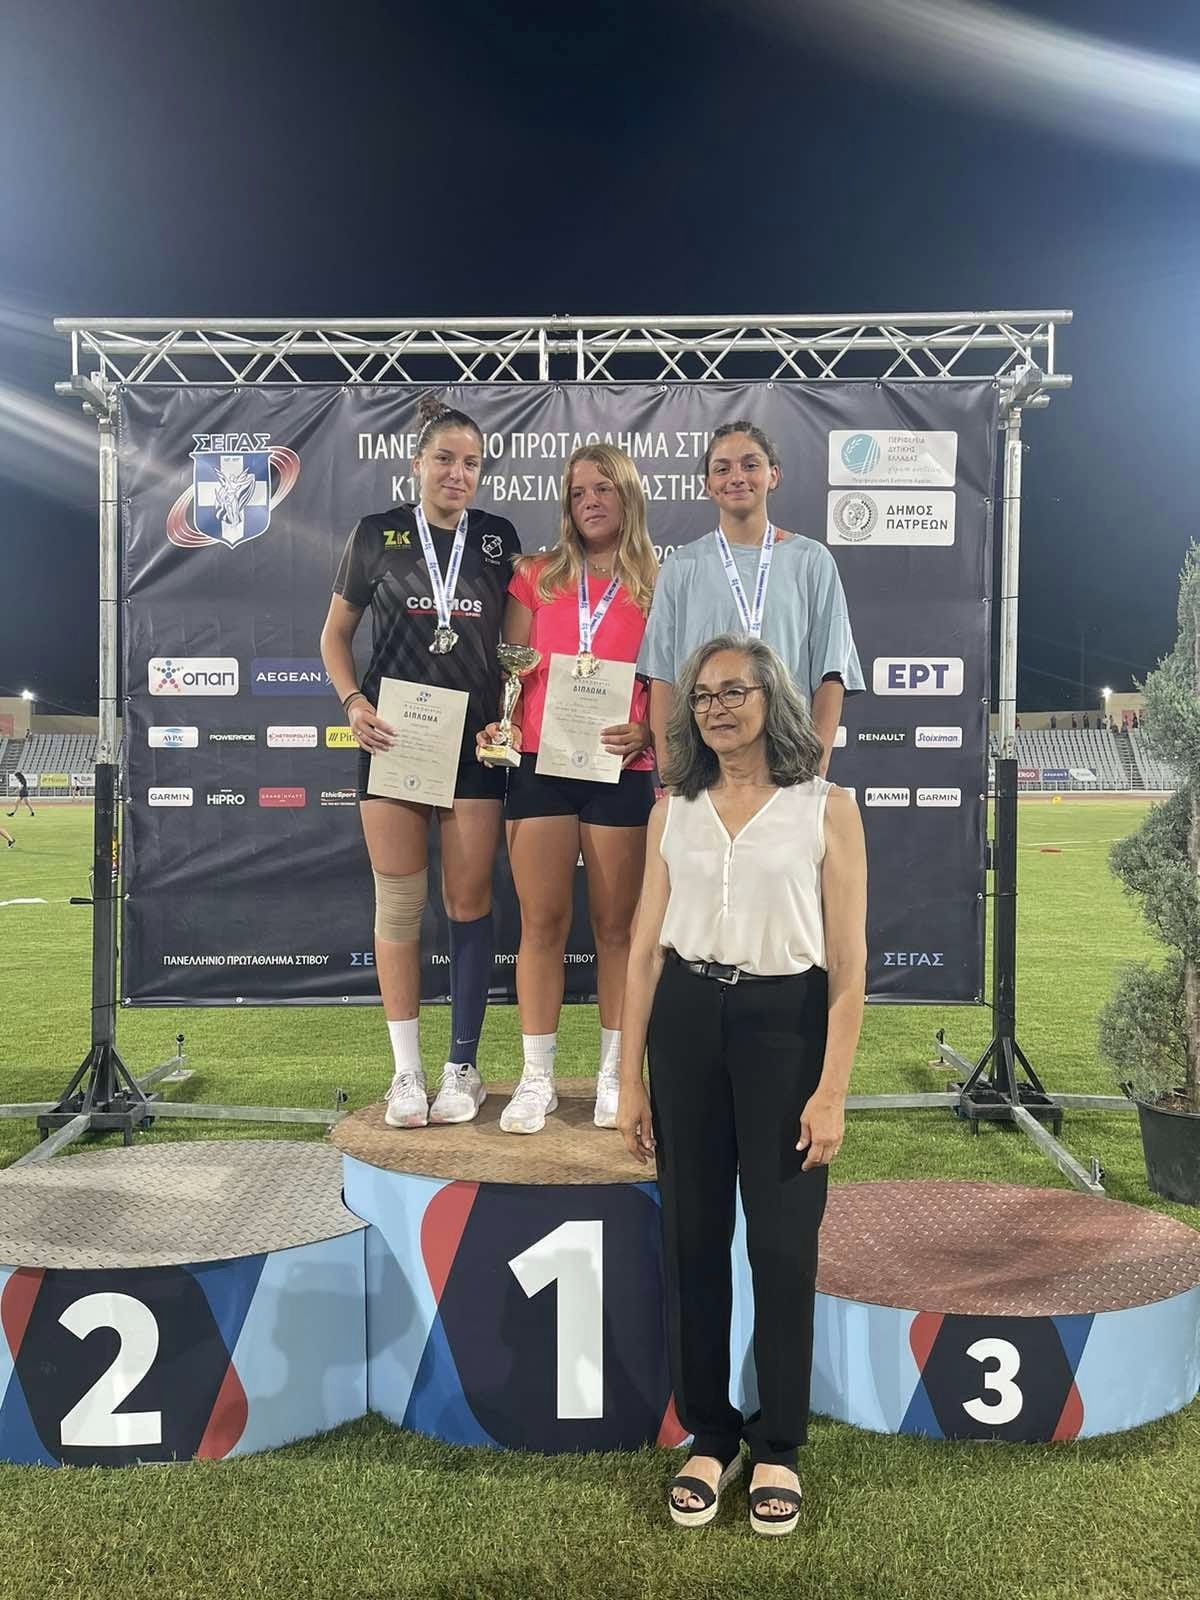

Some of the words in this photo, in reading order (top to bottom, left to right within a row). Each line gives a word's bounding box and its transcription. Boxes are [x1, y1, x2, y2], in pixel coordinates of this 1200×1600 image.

[192, 432, 271, 453] ΣΕΓΑΣ
[358, 432, 504, 459] ΠΑΝΕΙΟ
[675, 431, 714, 458] ΣΤΙ
[886, 504, 934, 516] ΔΗΜΟΣ
[886, 518, 949, 531] ΠΑΤΡΕΩΝ
[255, 671, 321, 683] AEGEAN
[887, 663, 950, 690] ΕΡΤ
[573, 685, 608, 696] ΔΙΠΛΩΜΑ
[403, 710, 439, 723] ΔΙΠΛΩΜΑ
[209, 733, 256, 741] POWERADE
[858, 733, 906, 741] RENAULT
[917, 733, 959, 742] Stoiximan
[150, 793, 190, 801] GARMIN
[206, 793, 246, 805] HiPRO
[320, 791, 357, 799] EthicSport
[918, 793, 958, 801] GARMIN
[163, 955, 226, 966] ΠΑΝΕΛΛΗΝΙΟ
[226, 955, 294, 966] ΠΡΩΤΑΘΛΗΜΑ
[295, 954, 329, 965] ΣΤΙΒΟΥ
[883, 952, 944, 966] ΣΕΓΑΣ
[507, 1219, 605, 1420] 1
[57, 1291, 163, 1447] 2
[961, 1337, 1024, 1425] 3
